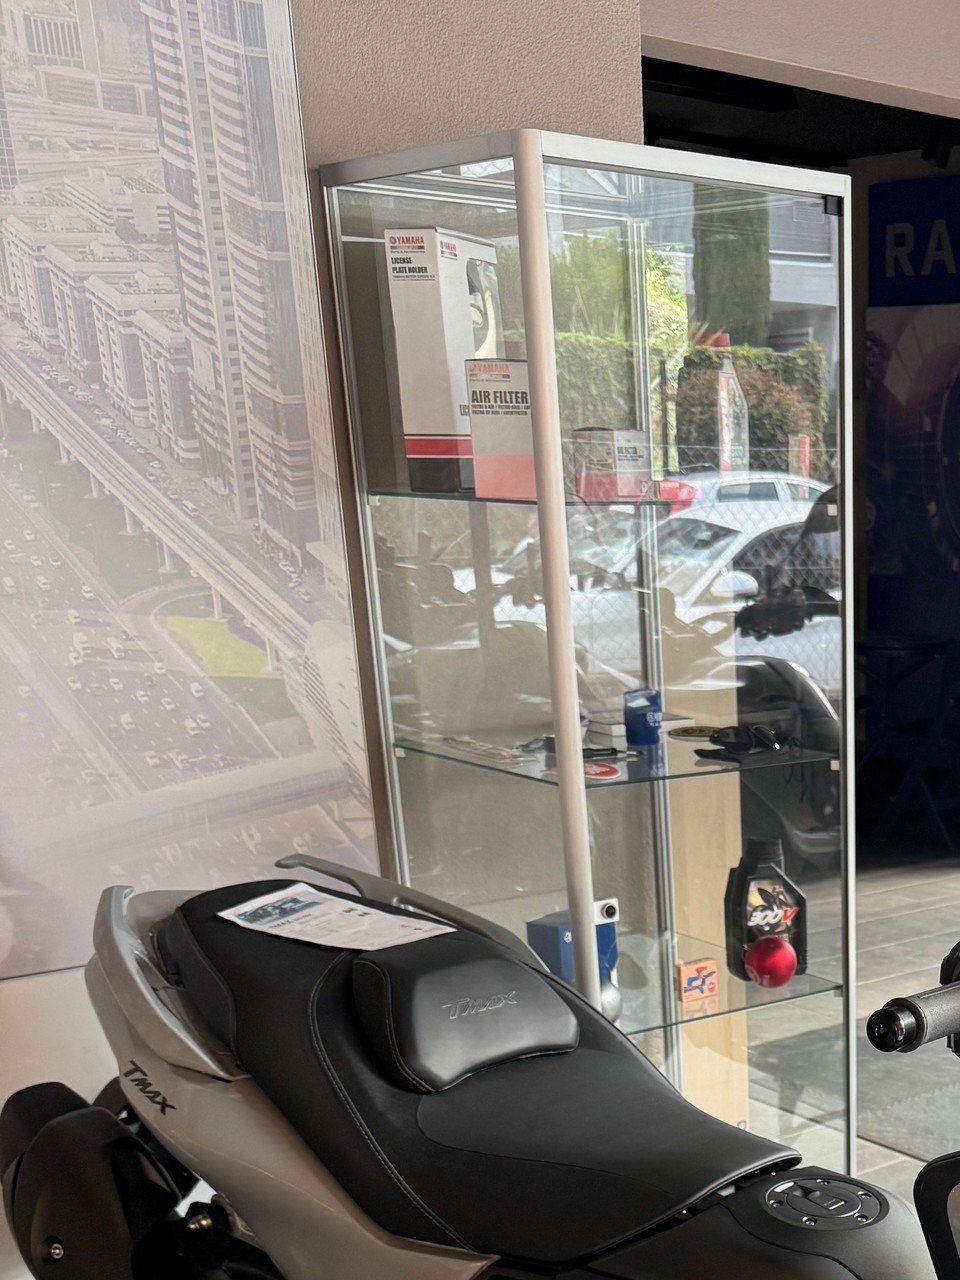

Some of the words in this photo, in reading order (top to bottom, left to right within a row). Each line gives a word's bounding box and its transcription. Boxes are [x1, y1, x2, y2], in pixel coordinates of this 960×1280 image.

[397, 236, 424, 244] YAMAHA
[478, 363, 510, 373] YAMAHA
[471, 390, 491, 403] AIR
[493, 391, 528, 404] FILTER
[747, 906, 800, 926] 300V
[123, 1060, 177, 1116] TMAX
